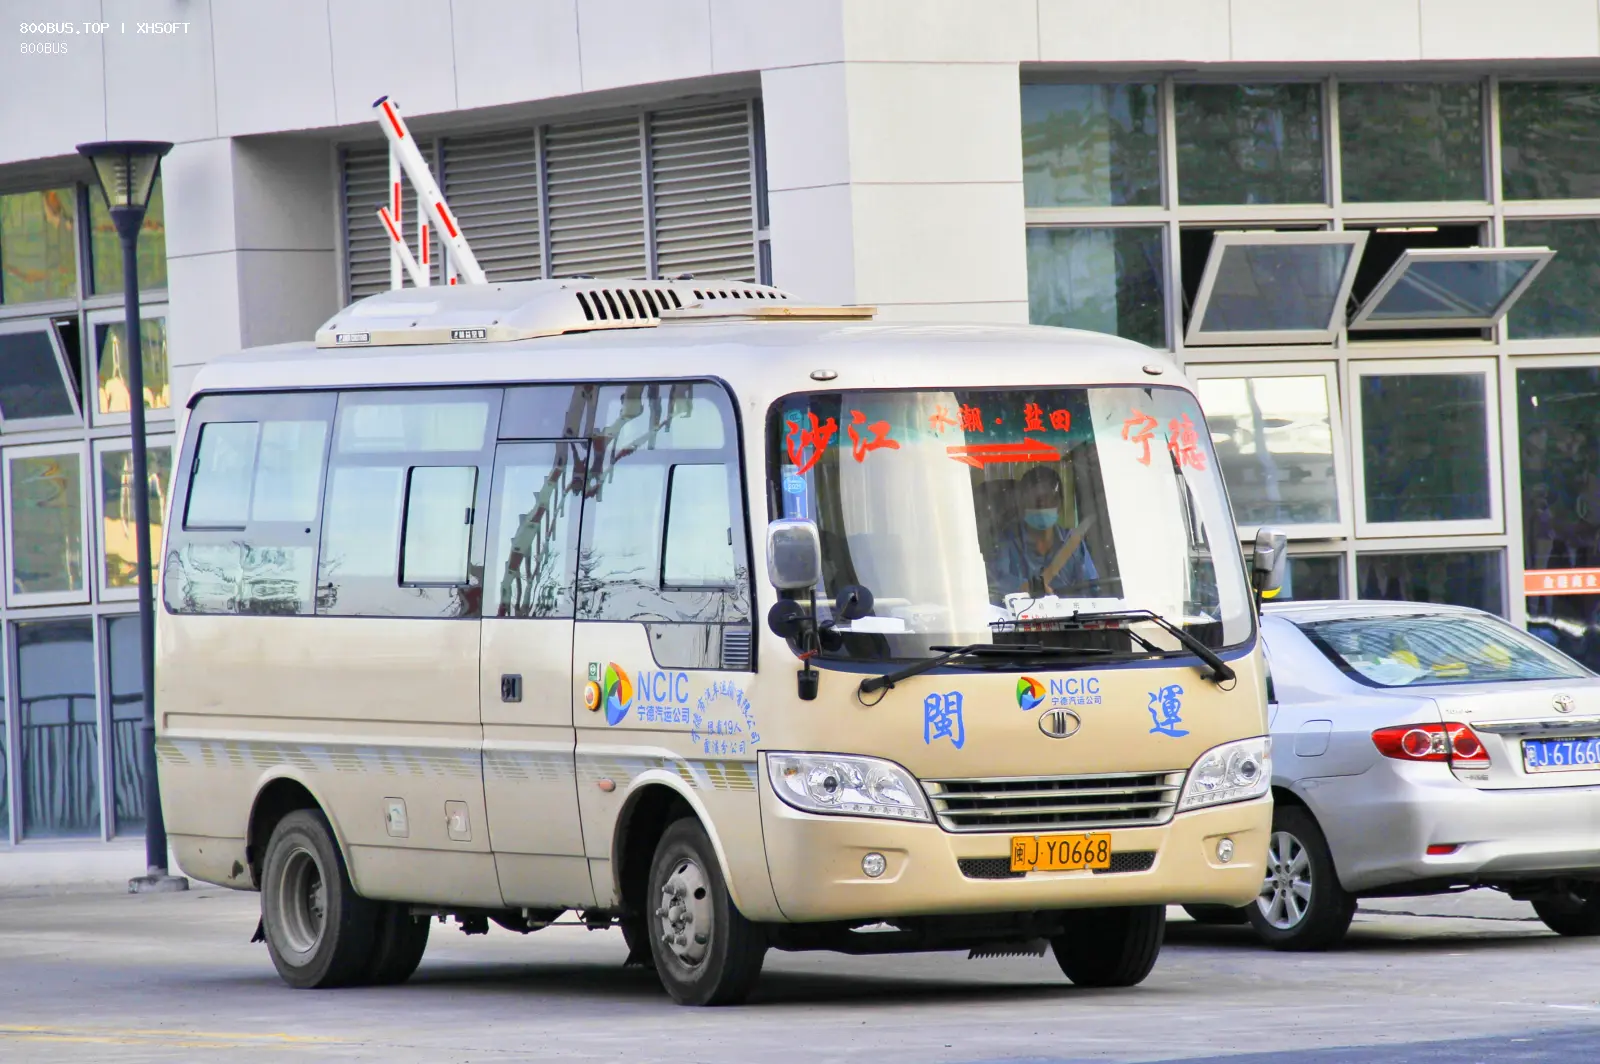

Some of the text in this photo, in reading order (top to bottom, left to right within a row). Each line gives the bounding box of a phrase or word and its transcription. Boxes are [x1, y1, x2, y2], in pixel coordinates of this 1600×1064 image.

[785, 409, 900, 475] 沙江
[1121, 408, 1206, 471] 宁德
[637, 671, 689, 704] NCIC
[1050, 677, 1101, 695] NCIC
[1051, 695, 1102, 706] 宁德汽运公司
[637, 705, 690, 724] 宁德汽运公司
